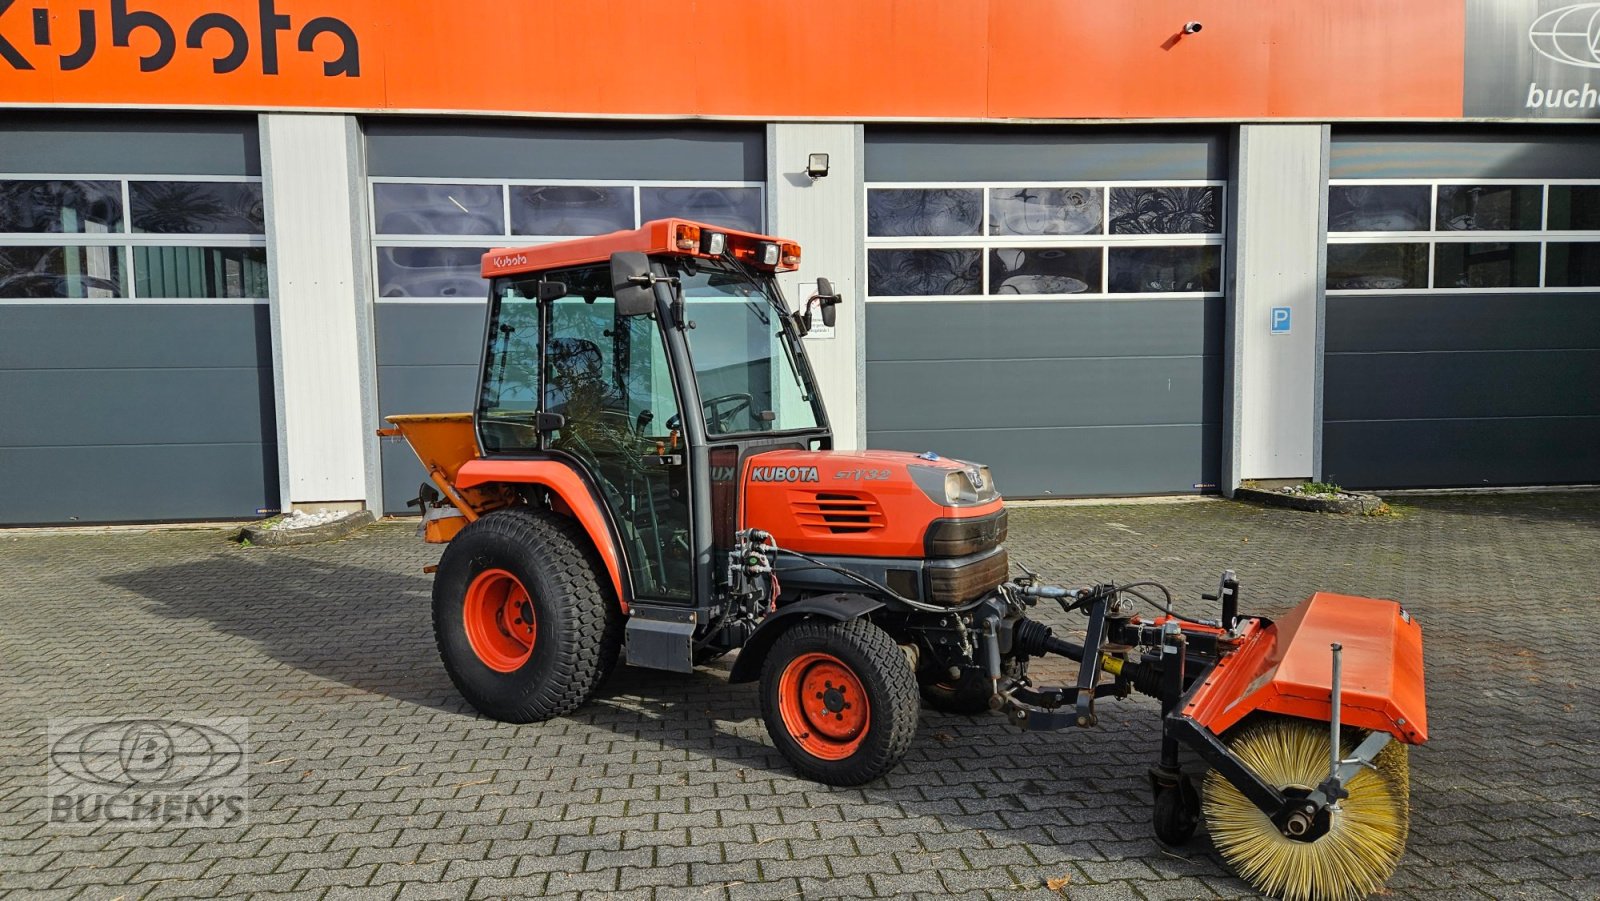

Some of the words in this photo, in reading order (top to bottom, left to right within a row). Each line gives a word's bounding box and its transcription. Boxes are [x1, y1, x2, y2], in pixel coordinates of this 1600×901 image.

[1525, 83, 1600, 108] buch
[493, 254, 527, 268] Kubota
[1274, 310, 1288, 328] P
[752, 466, 819, 482] KUBOTA
